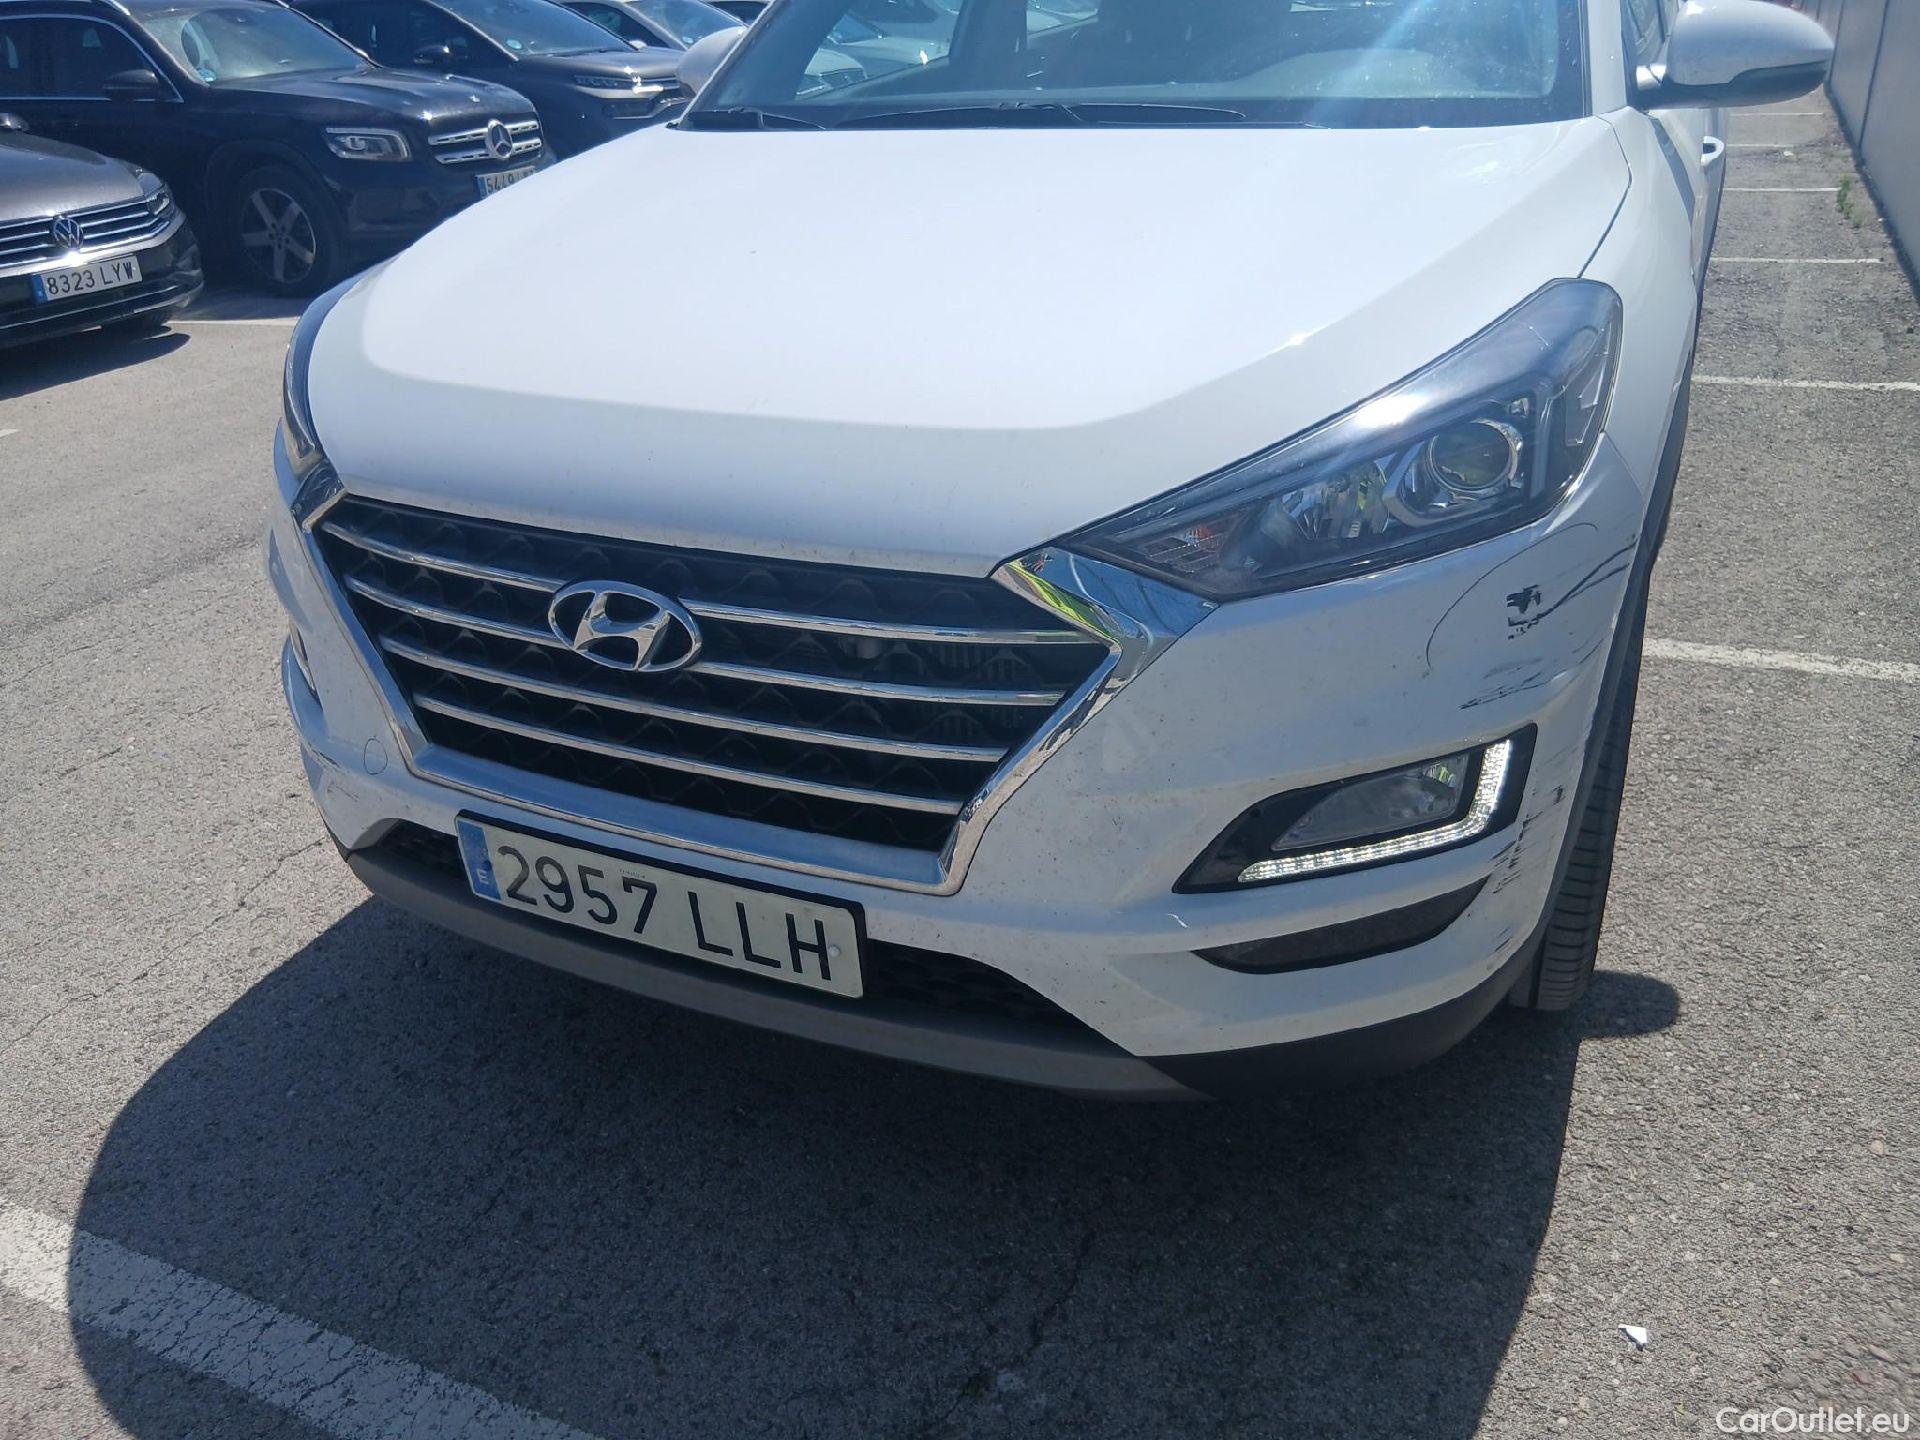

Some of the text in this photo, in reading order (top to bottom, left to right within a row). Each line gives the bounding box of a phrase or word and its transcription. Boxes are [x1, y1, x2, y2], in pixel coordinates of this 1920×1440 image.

[46, 261, 134, 295] 8323 LYW
[476, 868, 489, 885] E
[498, 845, 832, 981] 2957 LLH
